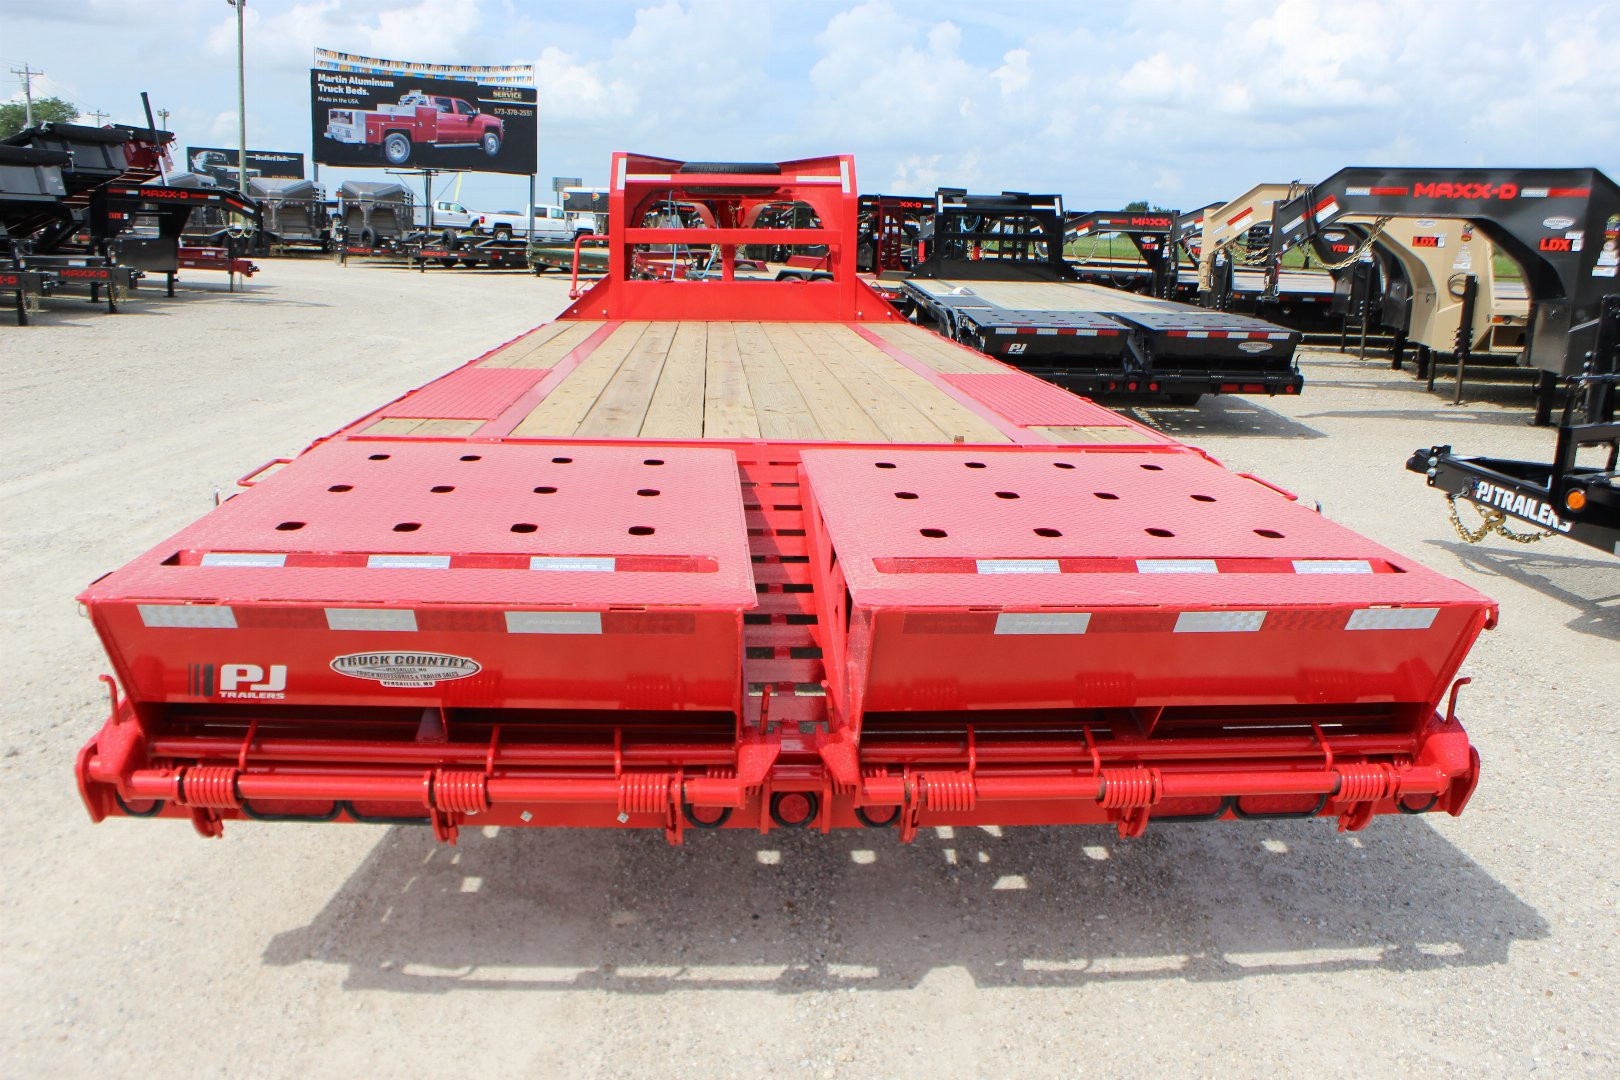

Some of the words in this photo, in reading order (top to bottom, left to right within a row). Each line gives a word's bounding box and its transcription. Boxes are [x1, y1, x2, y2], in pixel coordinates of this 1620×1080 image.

[317, 73, 348, 84] Martin
[349, 76, 394, 88] Aluminum
[317, 83, 344, 94] Truck
[345, 86, 370, 96] Beds.
[493, 91, 522, 99] SERVICE
[140, 189, 188, 199] MAXX-D
[1414, 182, 1517, 199] MAXX-D
[1412, 236, 1438, 247] LDX
[1539, 236, 1572, 251] LDX
[60, 269, 109, 278] MAXX-D
[1008, 343, 1027, 352] PJ
[1476, 480, 1495, 503] PJ
[338, 655, 391, 667] TRUCK
[394, 655, 468, 668] COUNTRY
[220, 664, 287, 692] PJ
[376, 672, 414, 680] ACCESSORIES
[420, 672, 442, 680] TRAILER
[442, 671, 460, 679] SALES
[219, 690, 285, 700] TRAILERS
